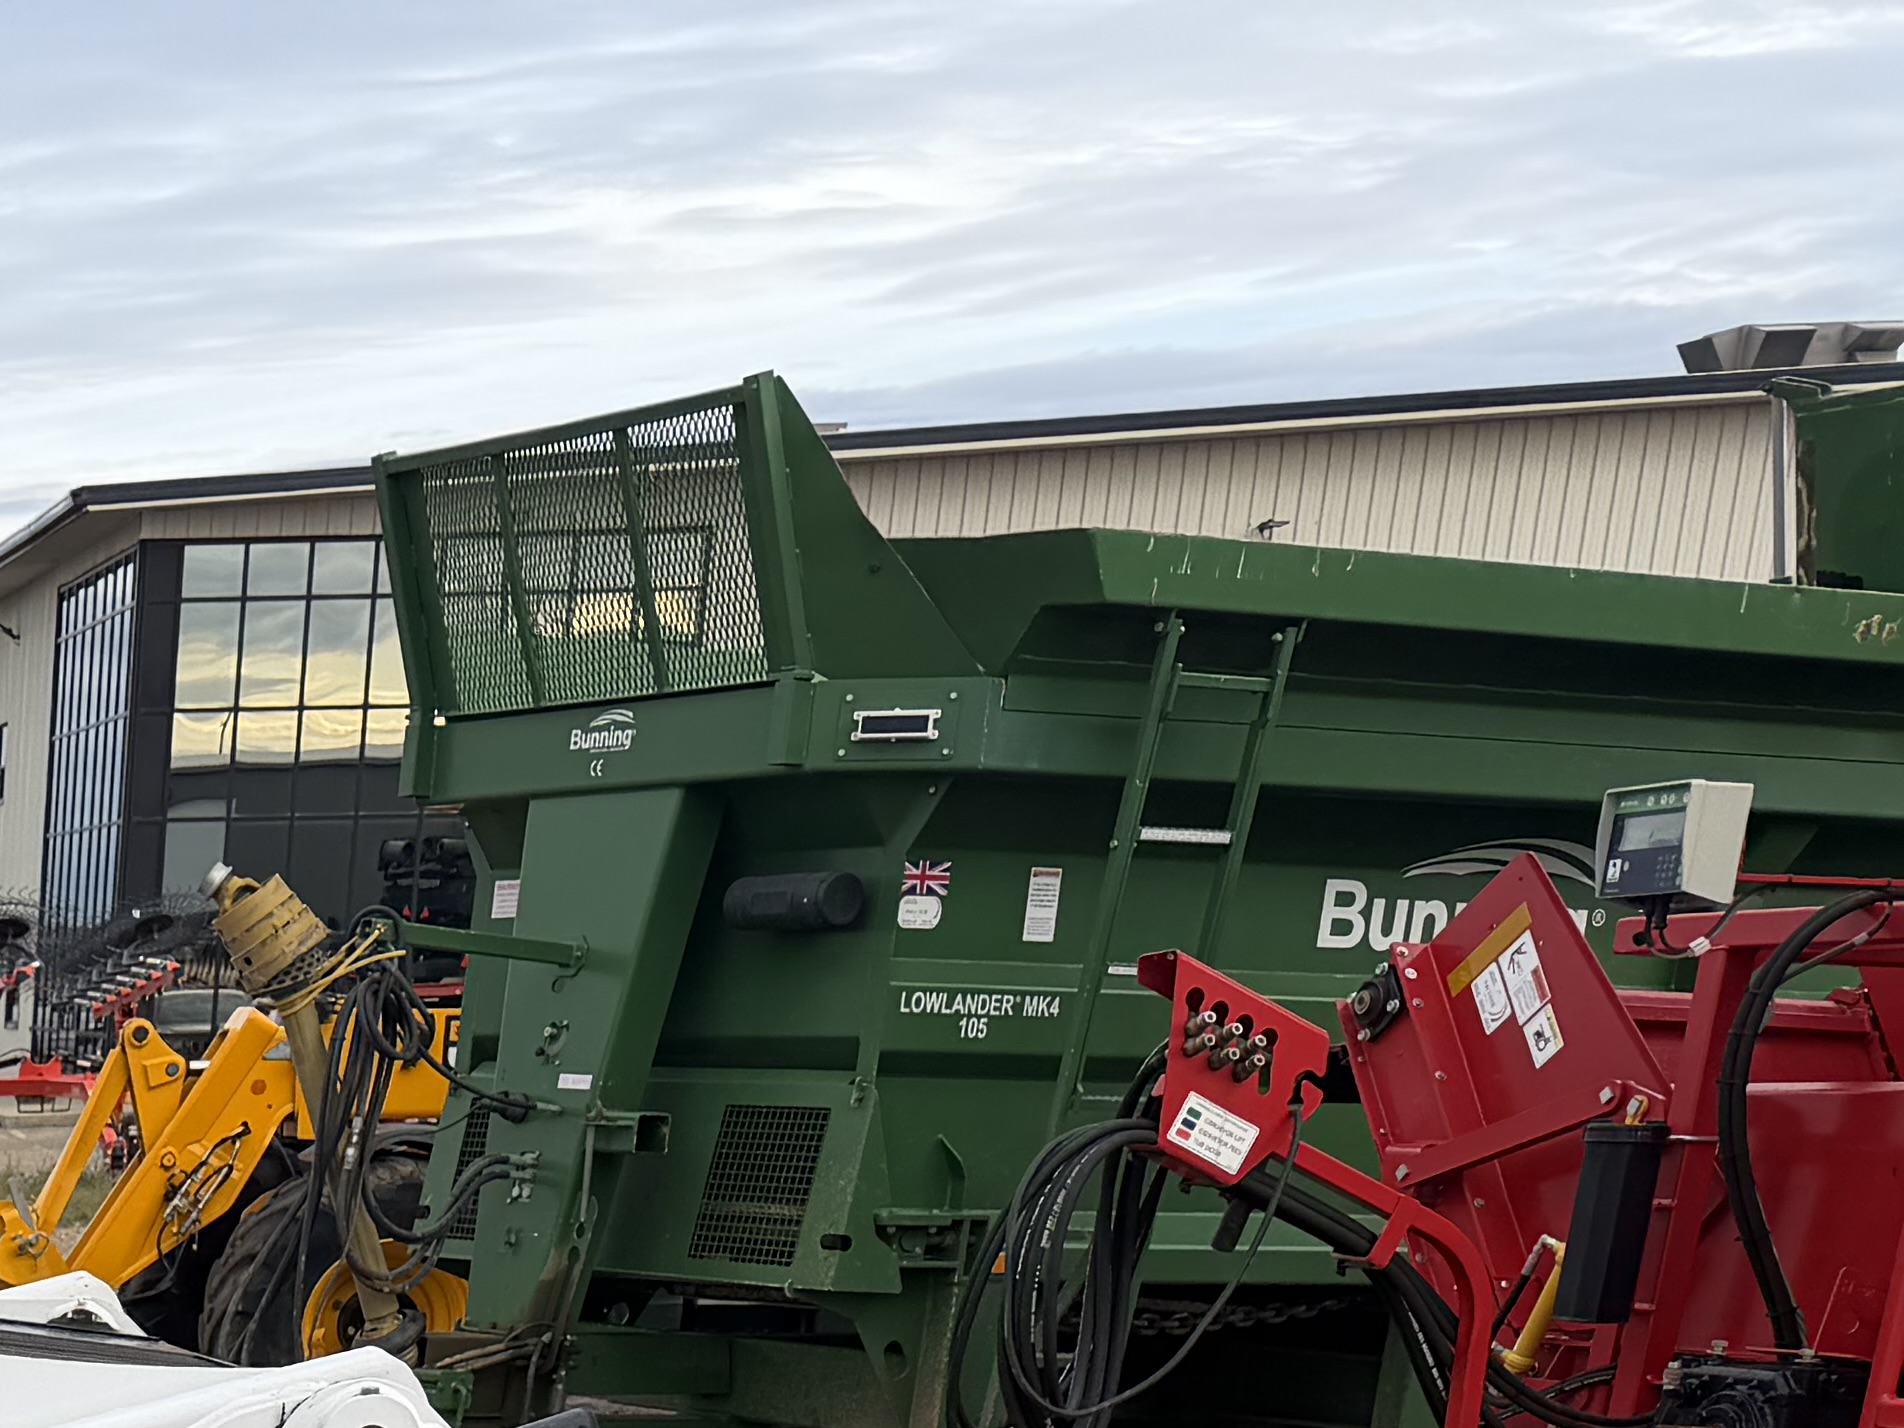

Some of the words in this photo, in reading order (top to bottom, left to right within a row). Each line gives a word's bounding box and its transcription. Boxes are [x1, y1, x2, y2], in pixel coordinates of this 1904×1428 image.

[569, 725, 632, 750] Bunning
[900, 991, 1013, 1017] LOWLANDER
[1022, 995, 1061, 1018] MK4
[958, 1016, 989, 1039] 105
